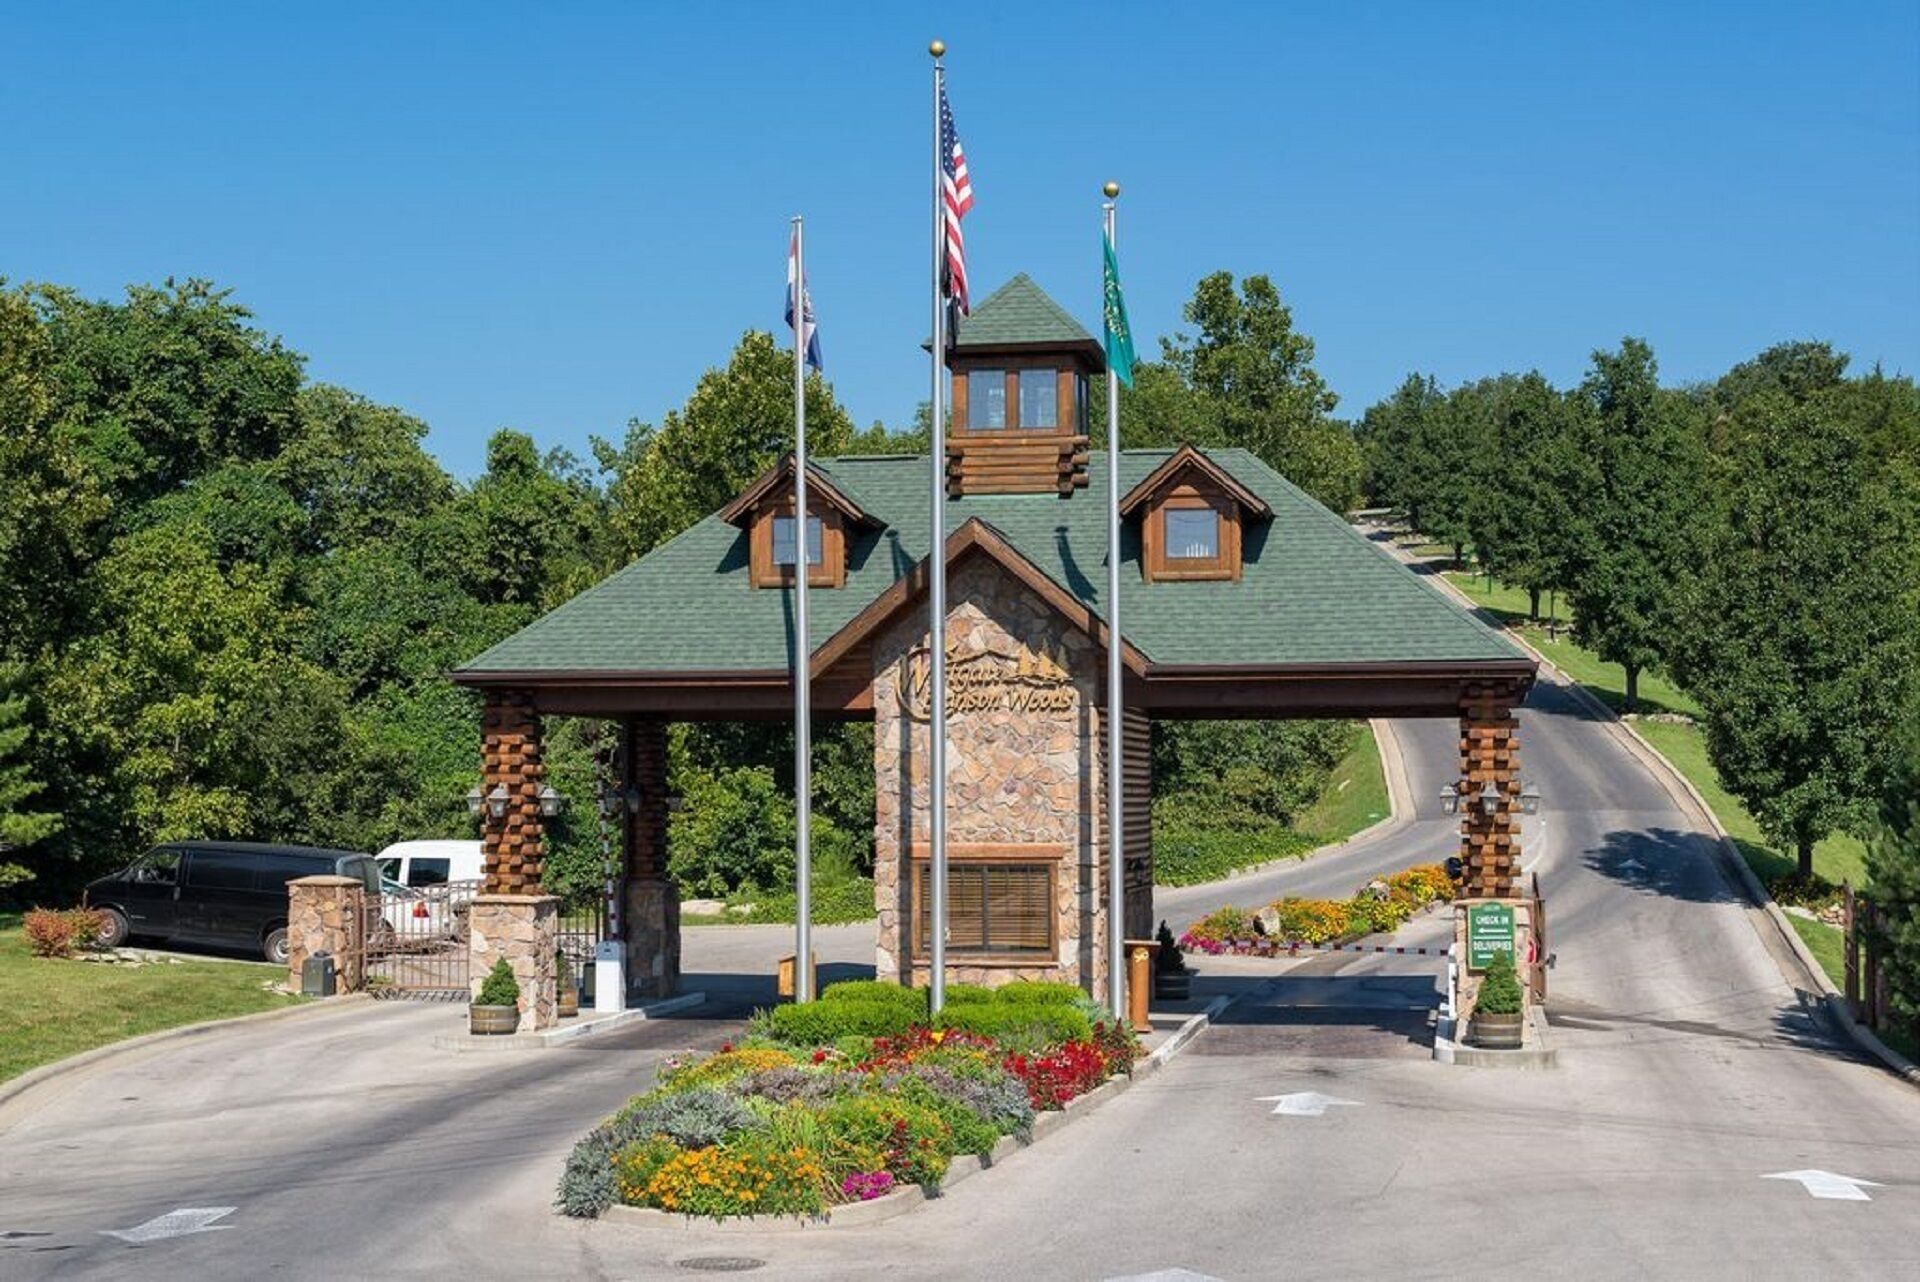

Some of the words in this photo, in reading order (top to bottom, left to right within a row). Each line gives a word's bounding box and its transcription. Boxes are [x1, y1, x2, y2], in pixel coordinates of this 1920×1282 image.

[1007, 687, 1074, 713] Woods
[1475, 915, 1499, 925] CHECK
[1501, 915, 1509, 925] IN
[1473, 940, 1512, 951] DELIVERIES
